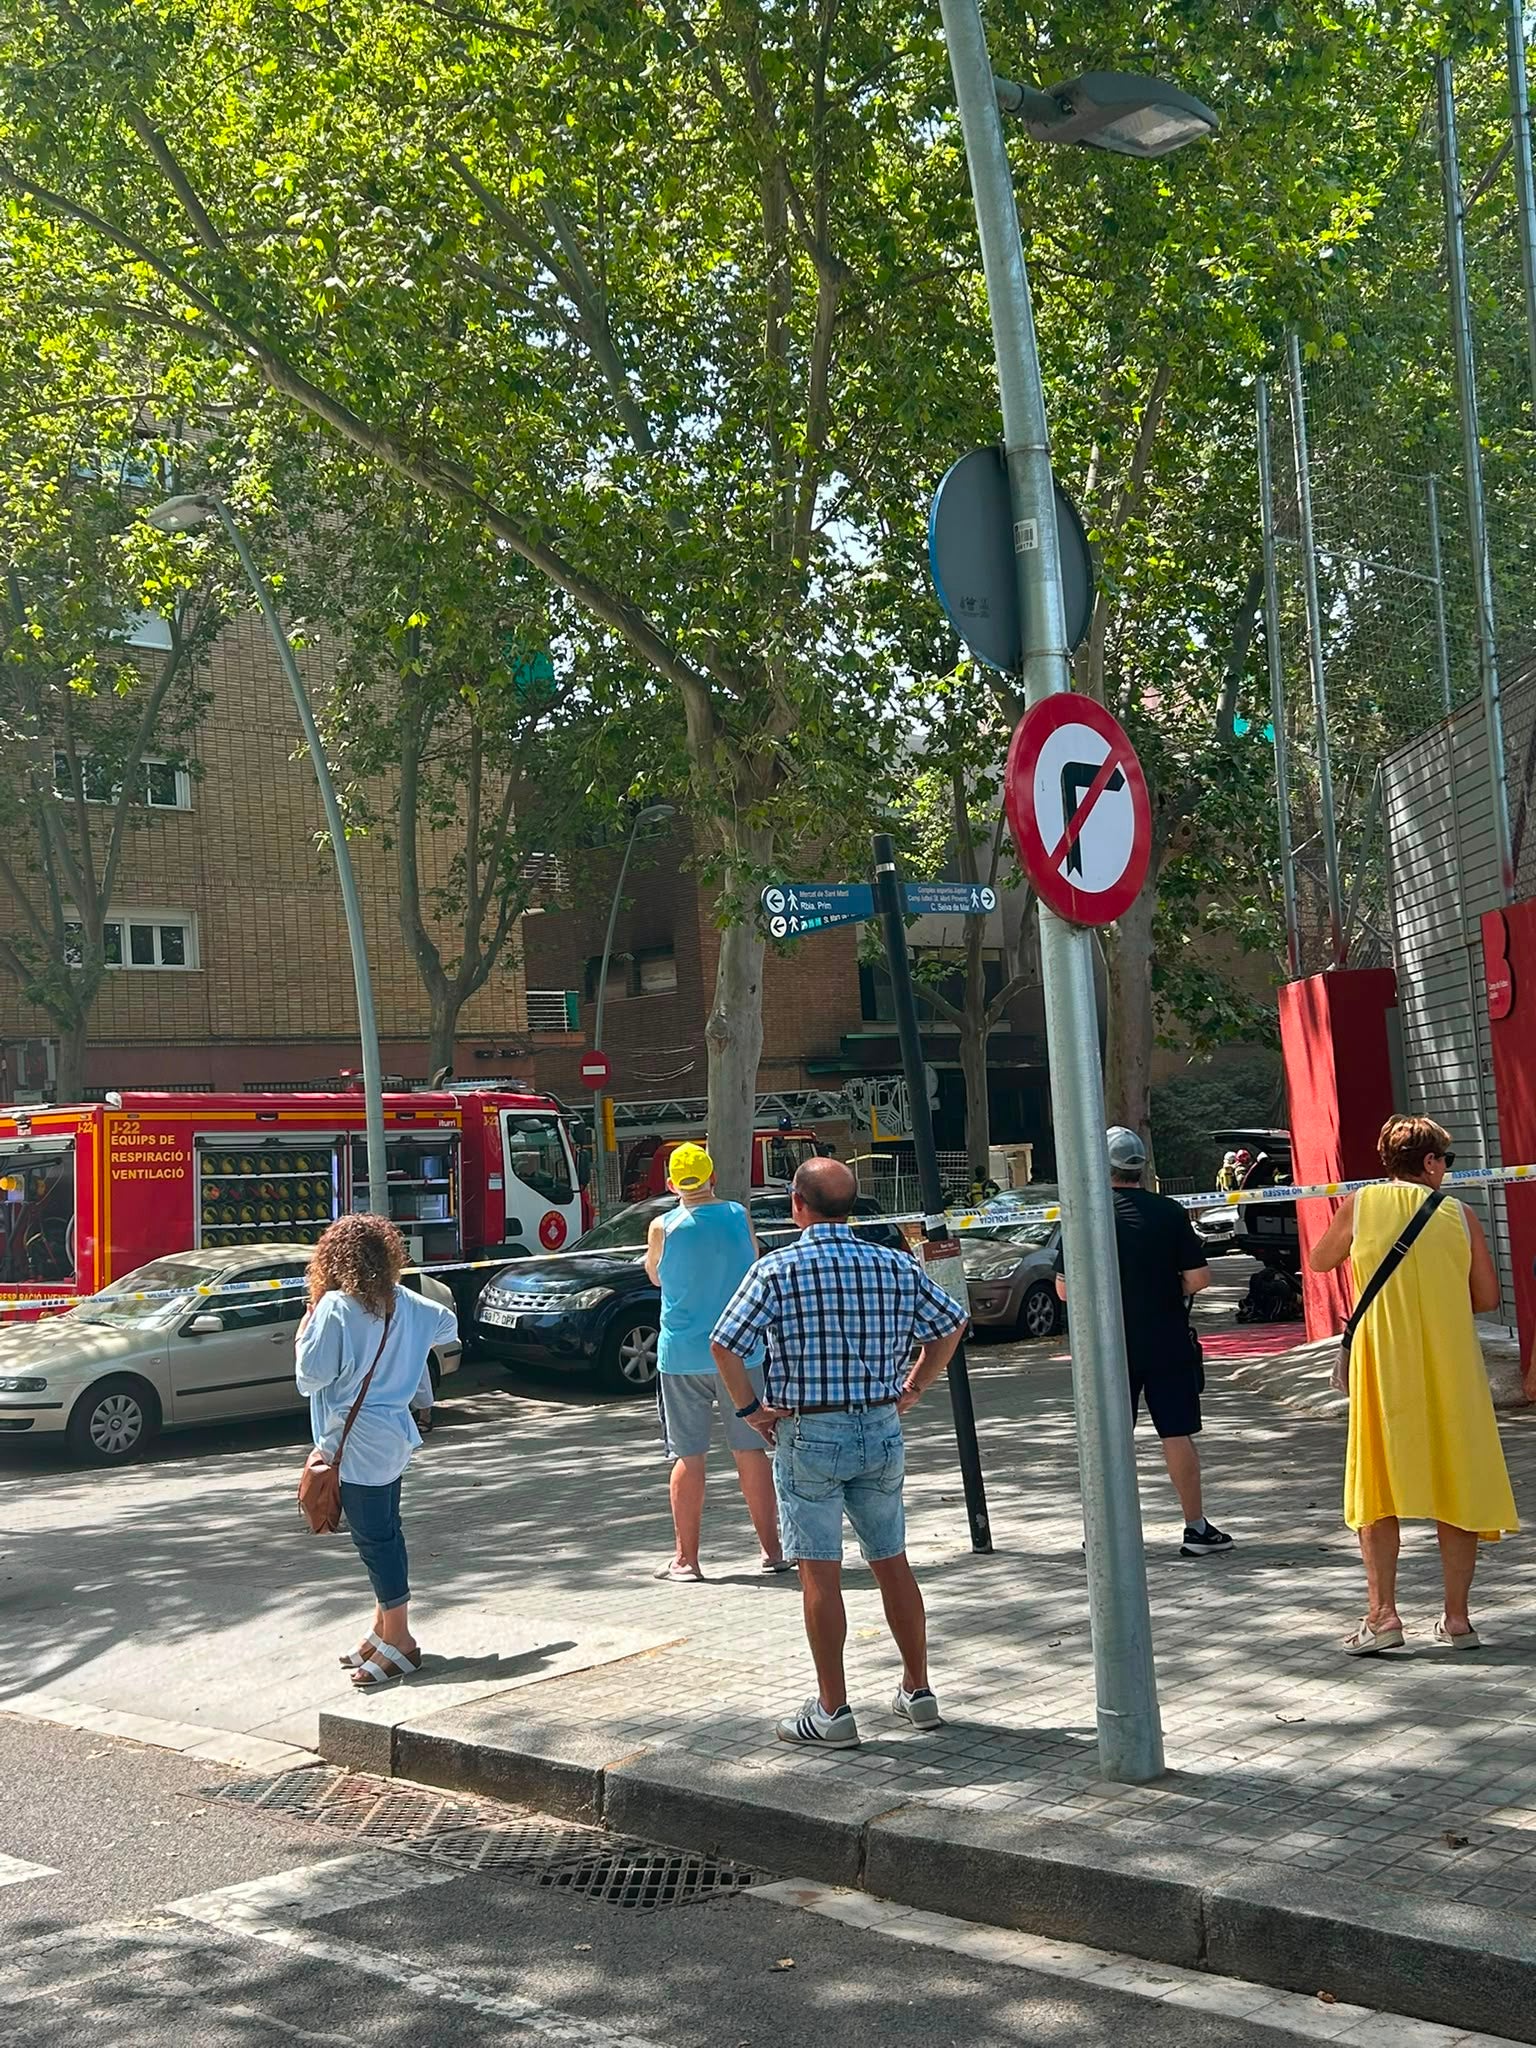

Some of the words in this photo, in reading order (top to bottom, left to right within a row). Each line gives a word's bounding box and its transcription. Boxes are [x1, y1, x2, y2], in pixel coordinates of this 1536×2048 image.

[77, 1121, 93, 1134] J-22
[111, 1121, 141, 1135] J-22
[111, 1135, 157, 1146] EQUIPS
[159, 1134, 176, 1145] DE
[111, 1150, 184, 1163] RESPIRACIÓ
[186, 1151, 191, 1161] I
[111, 1166, 185, 1180] VENTILACIÓ
[1262, 1188, 1290, 1198] PASSEU
[1291, 1187, 1303, 1195] NO
[979, 1214, 1009, 1225] POLICIA
